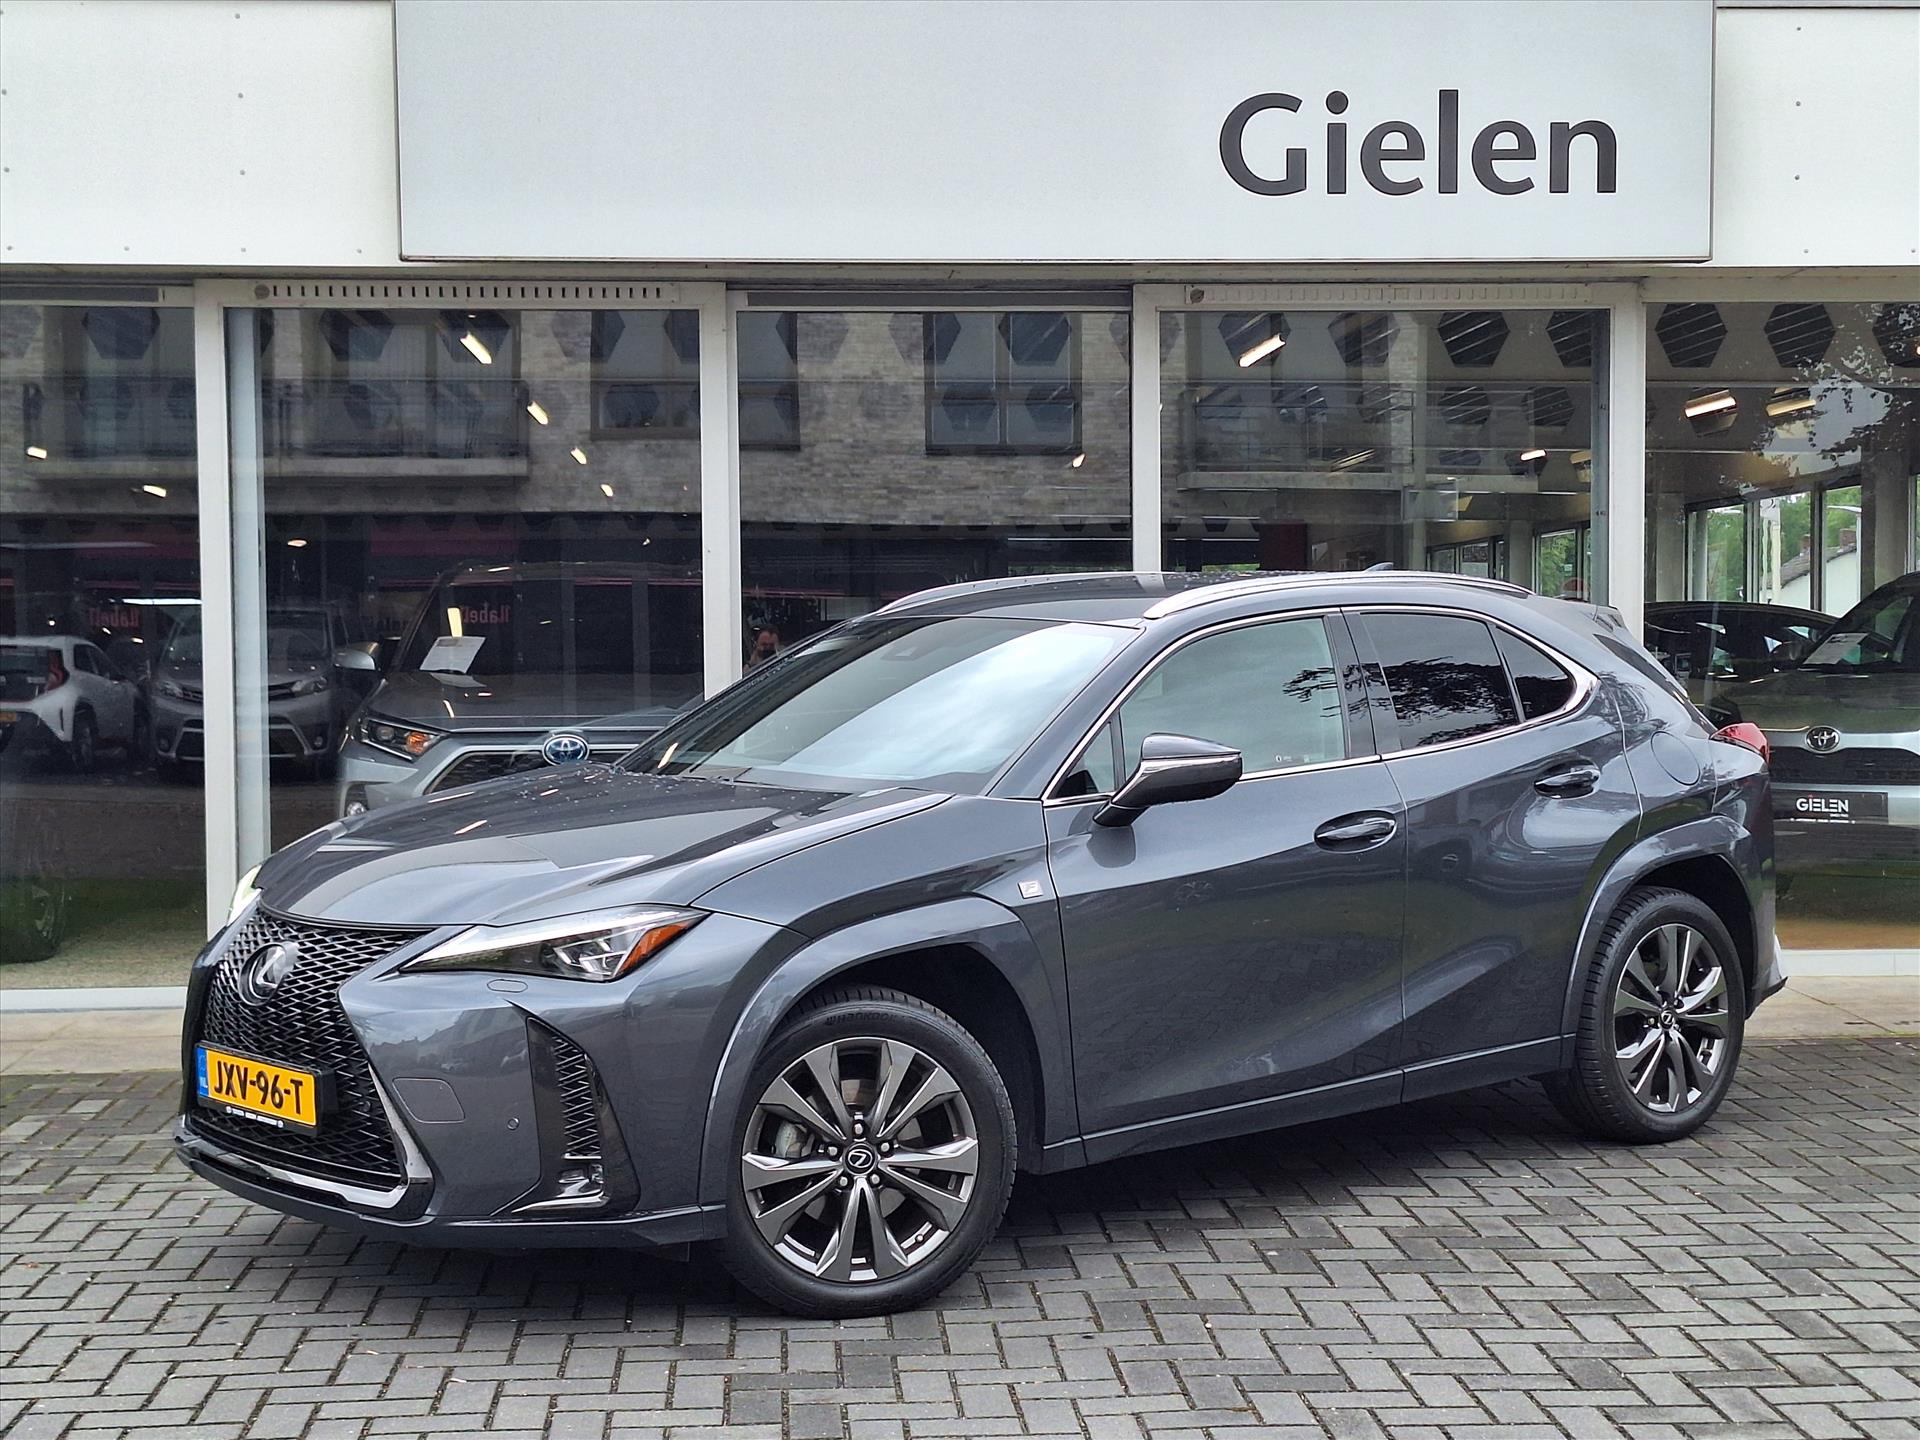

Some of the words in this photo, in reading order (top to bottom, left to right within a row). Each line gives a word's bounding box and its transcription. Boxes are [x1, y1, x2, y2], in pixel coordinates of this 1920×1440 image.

[1219, 89, 1617, 197] Gielen
[1796, 796, 1849, 812] GIELEN
[214, 1060, 304, 1115] JXV-96-T
